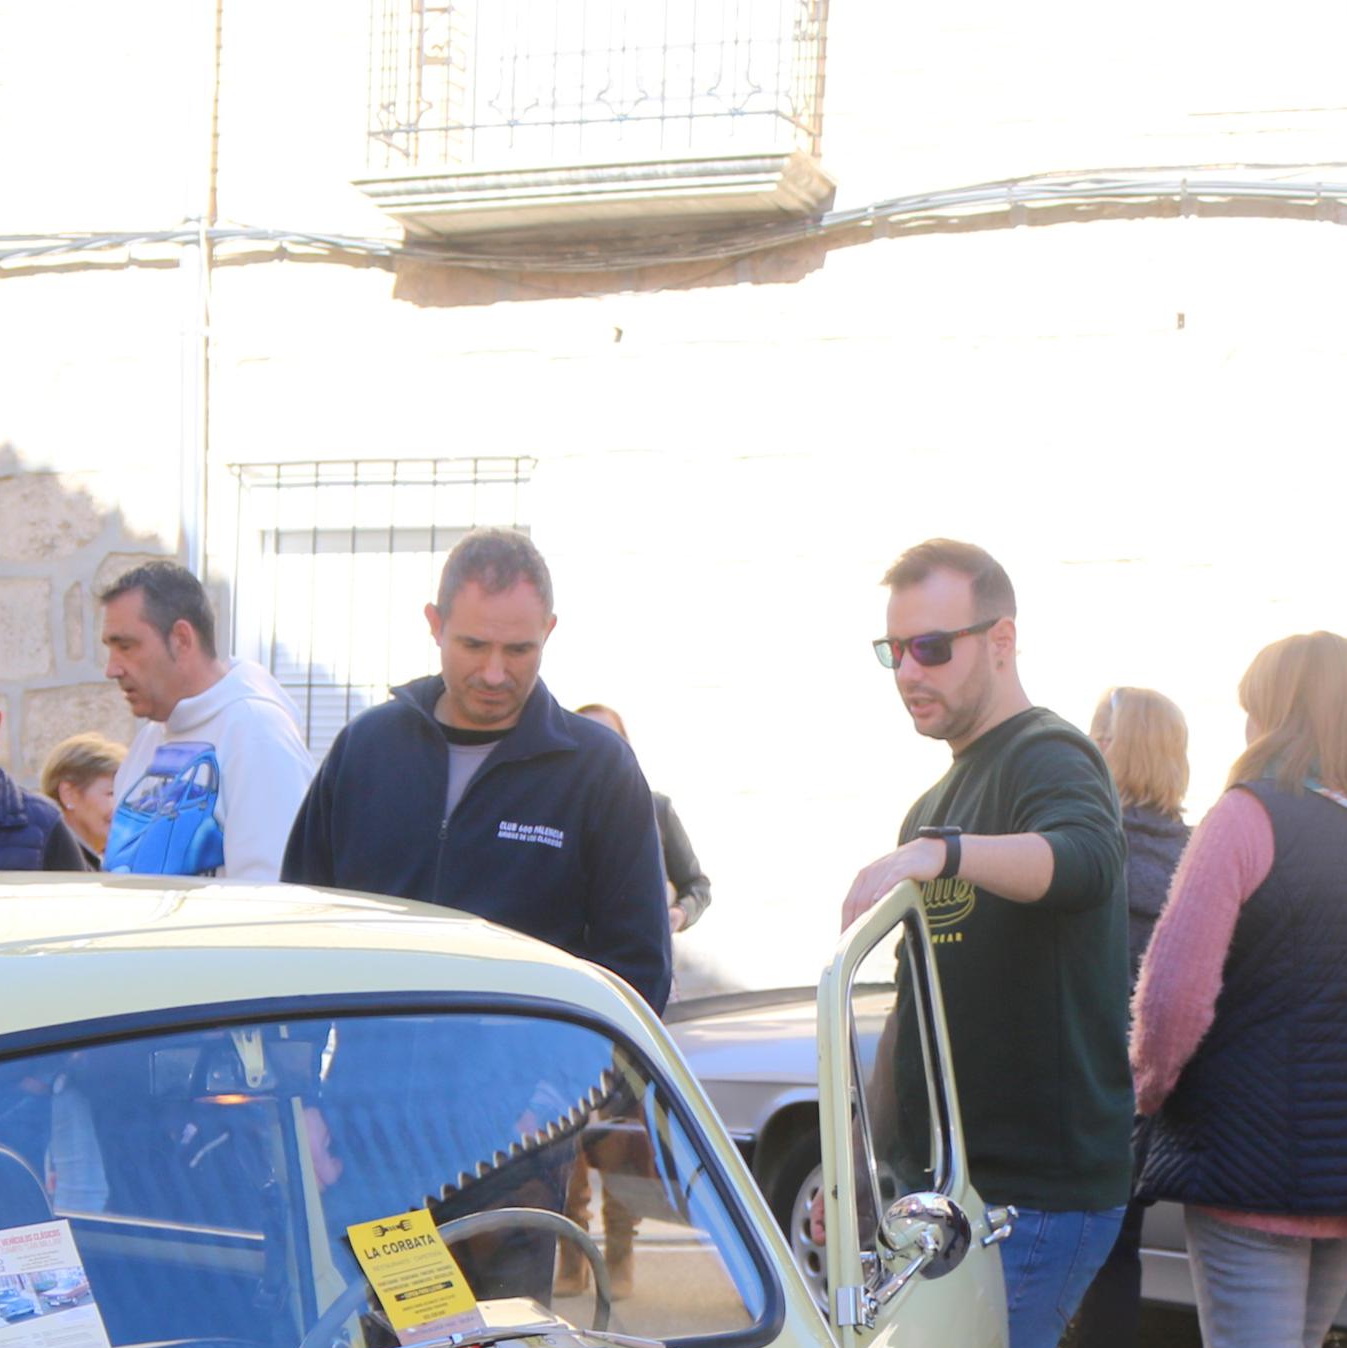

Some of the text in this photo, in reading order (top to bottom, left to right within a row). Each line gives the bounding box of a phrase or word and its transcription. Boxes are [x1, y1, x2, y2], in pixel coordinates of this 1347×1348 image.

[499, 821, 518, 831] CLUB
[364, 1234, 436, 1260] LA CORBATA
